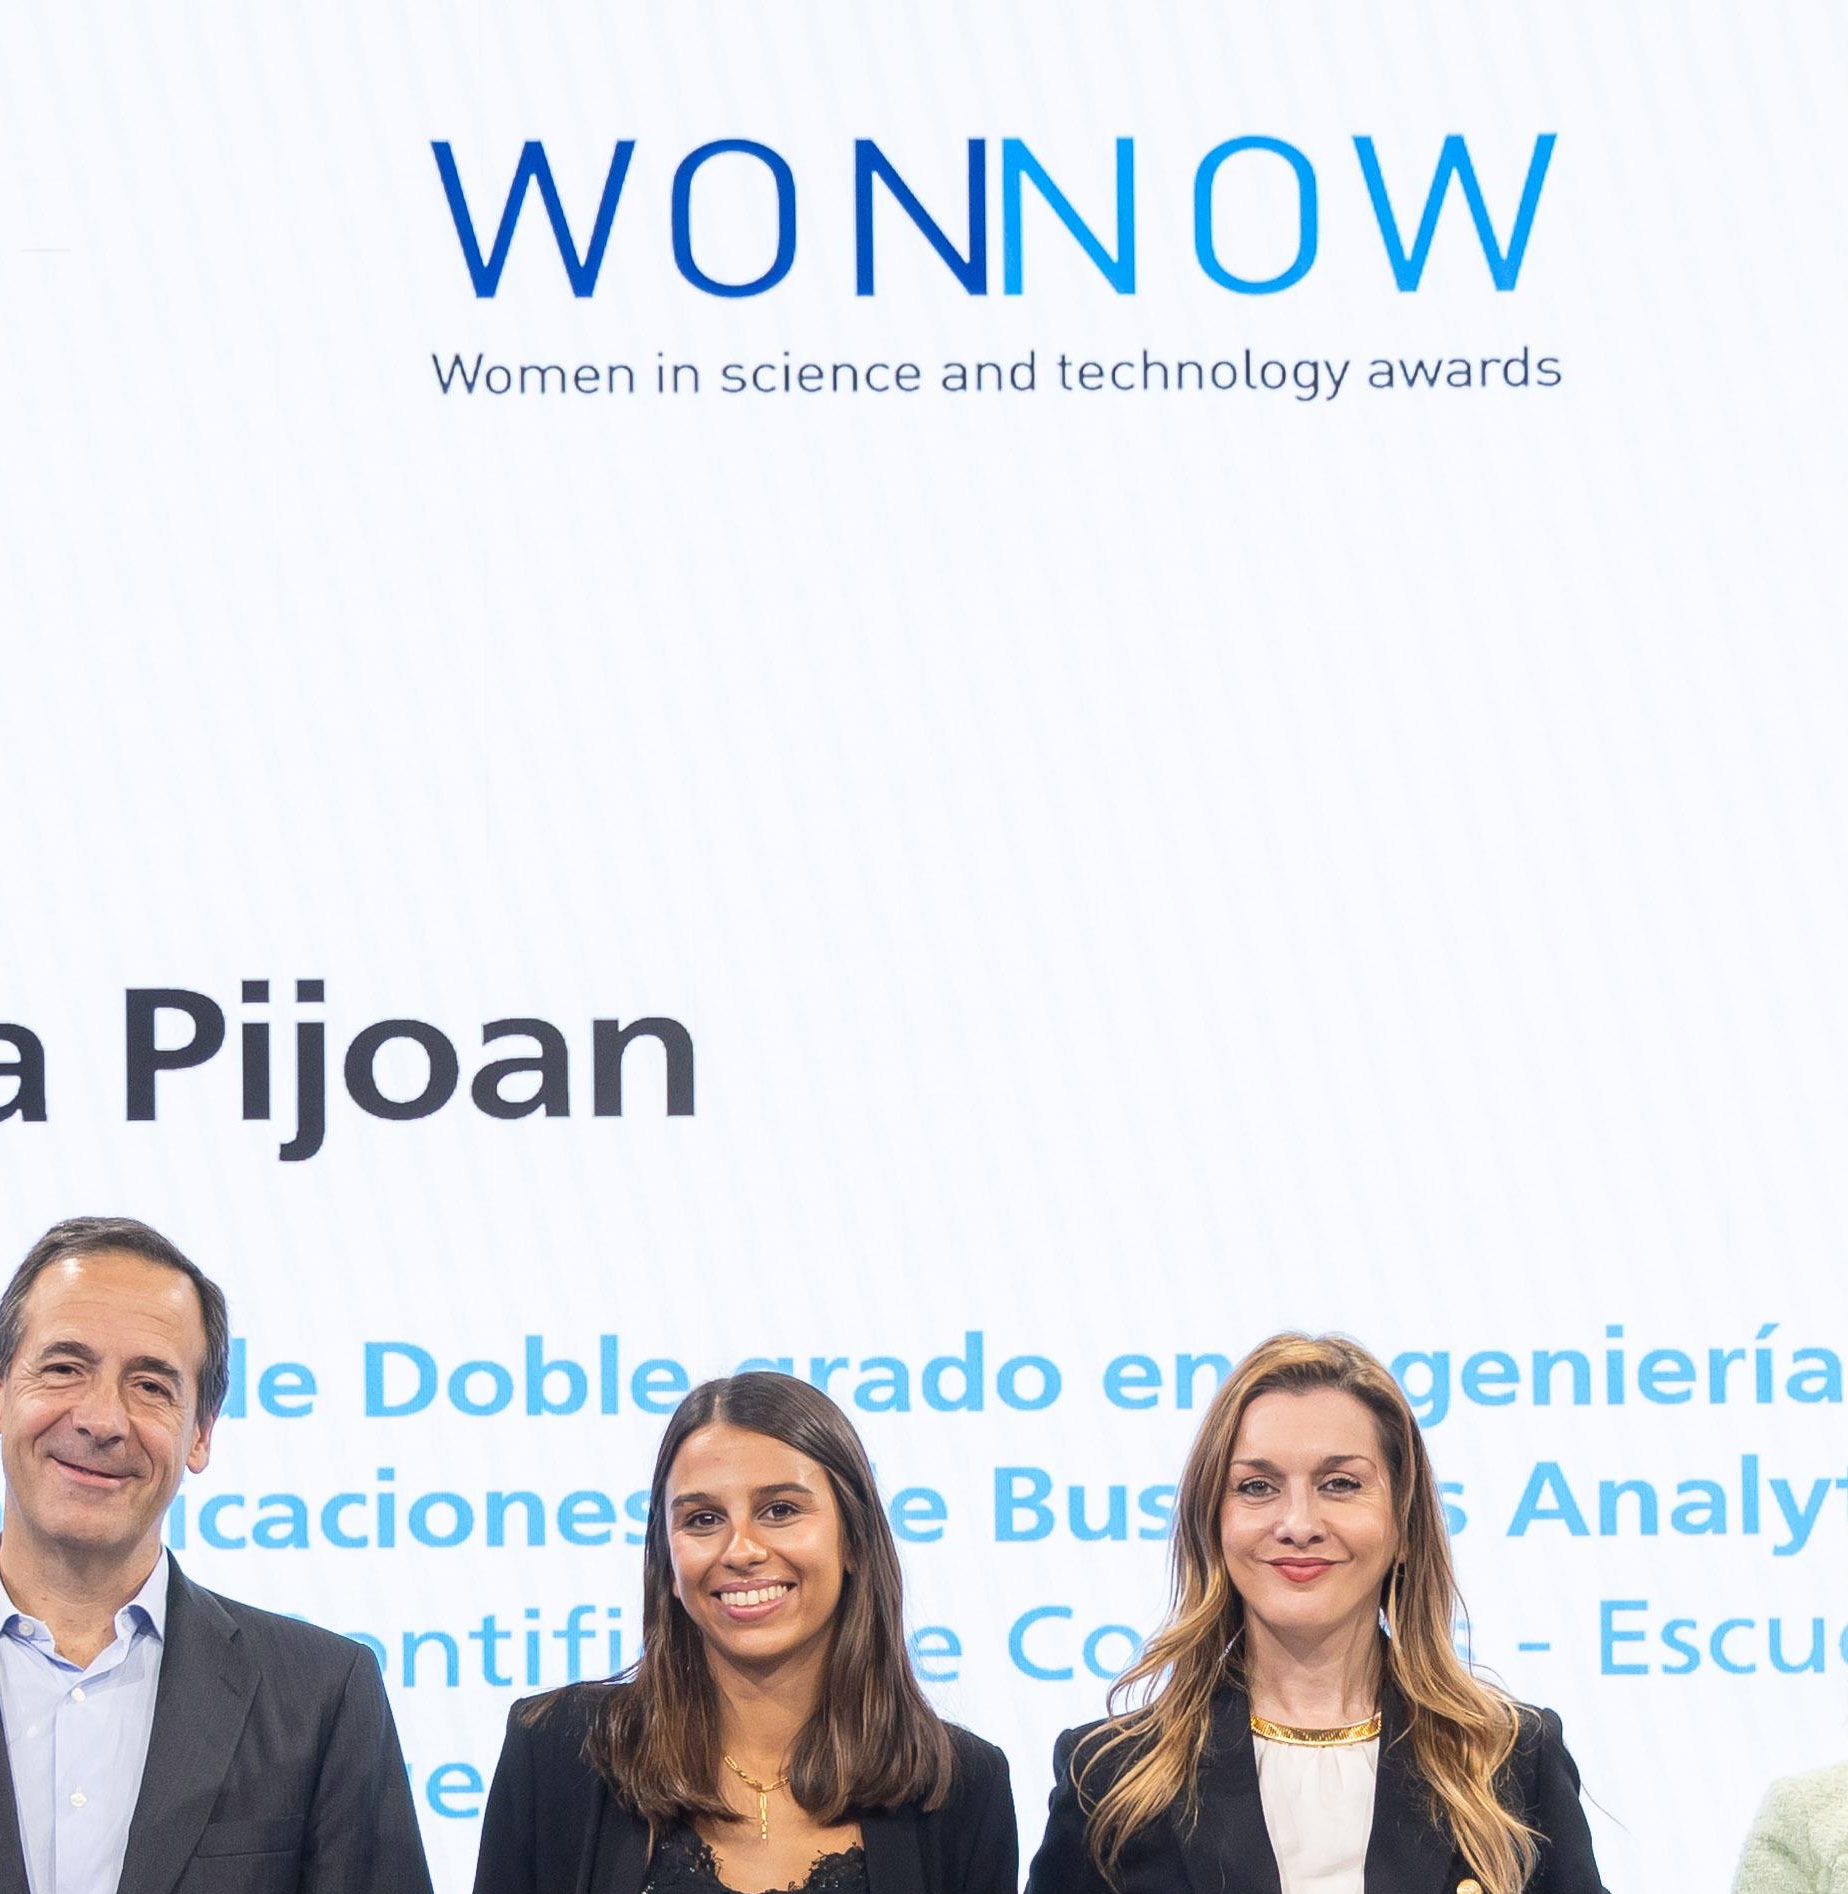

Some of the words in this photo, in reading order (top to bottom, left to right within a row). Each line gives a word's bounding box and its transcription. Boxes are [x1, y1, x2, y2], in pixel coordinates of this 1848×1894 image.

[431, 134, 1558, 299] WONNOW
[431, 353, 634, 395] Women
[658, 351, 699, 393] in
[722, 350, 921, 393] science
[941, 350, 1035, 392] and
[1058, 348, 1350, 402] technology
[1368, 346, 1562, 389] awards
[125, 979, 695, 1162] Pijoan
[363, 1333, 691, 1418] Doble
